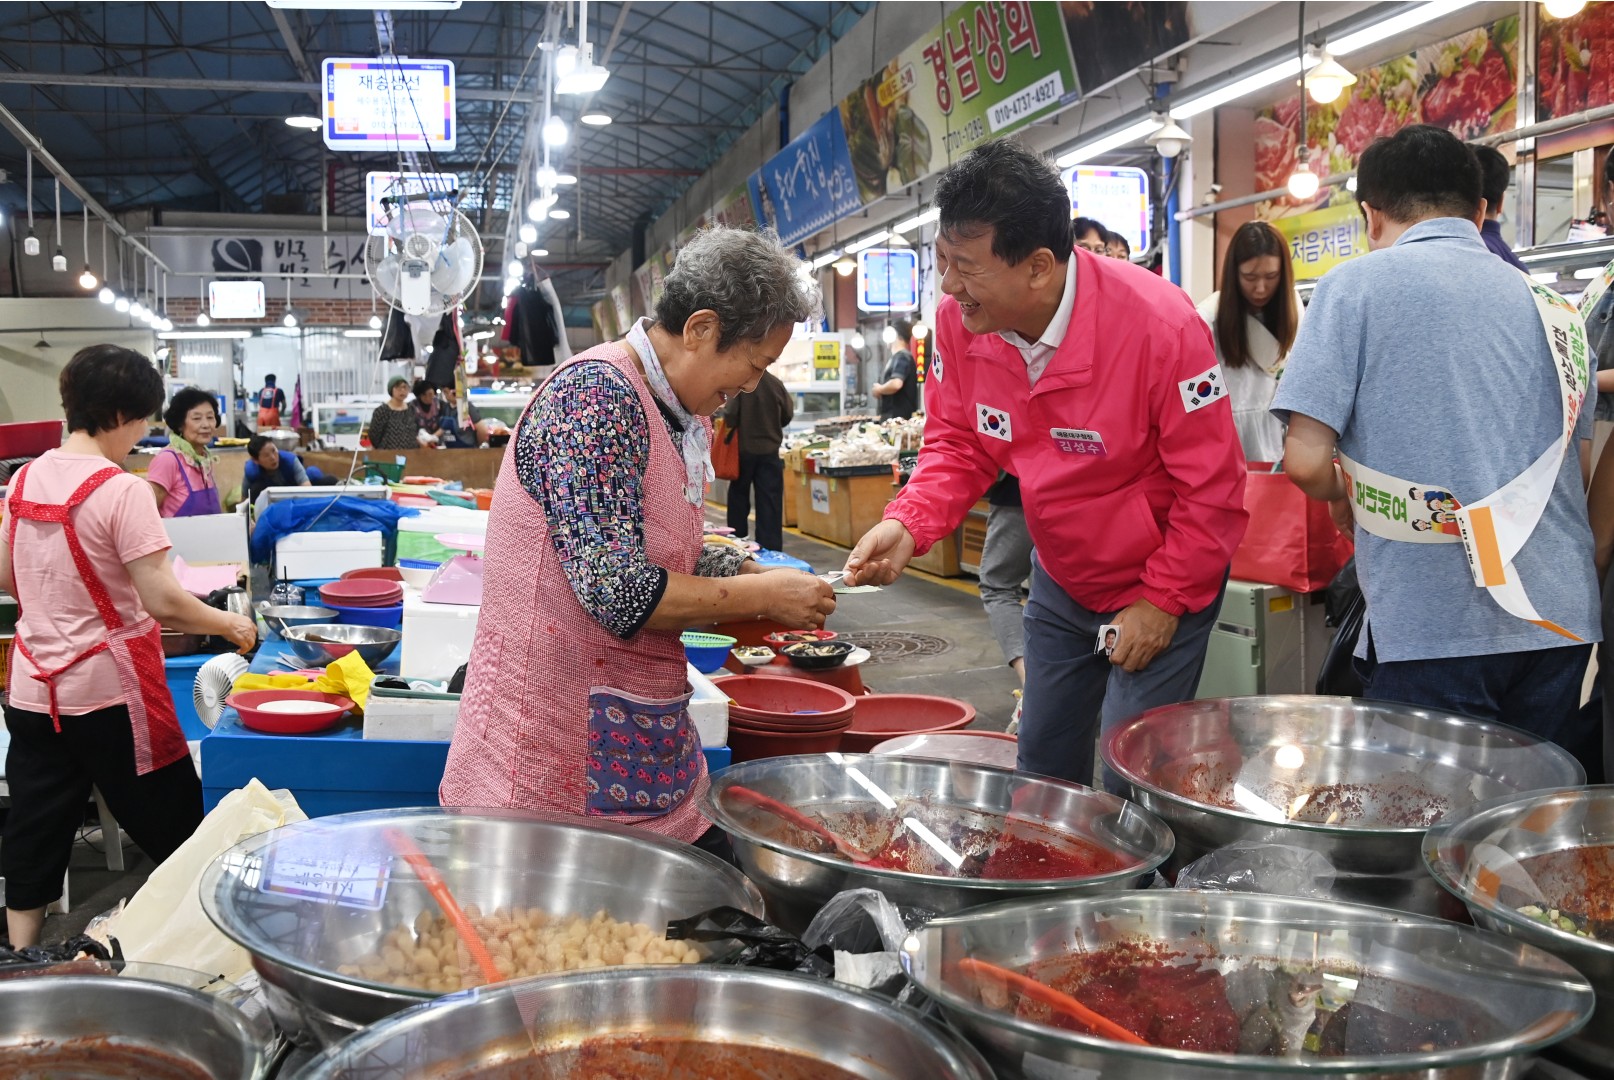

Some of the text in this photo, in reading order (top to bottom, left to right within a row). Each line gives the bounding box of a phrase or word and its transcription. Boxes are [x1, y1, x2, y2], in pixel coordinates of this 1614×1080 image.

[922, 1, 1041, 116] 경남상회
[358, 74, 420, 92] 재송생선
[994, 79, 1056, 124] 010-4737-4927
[1291, 217, 1360, 264] 처음처럼!
[1059, 440, 1100, 454] 김성수
[1355, 480, 1408, 524] 보내세요
